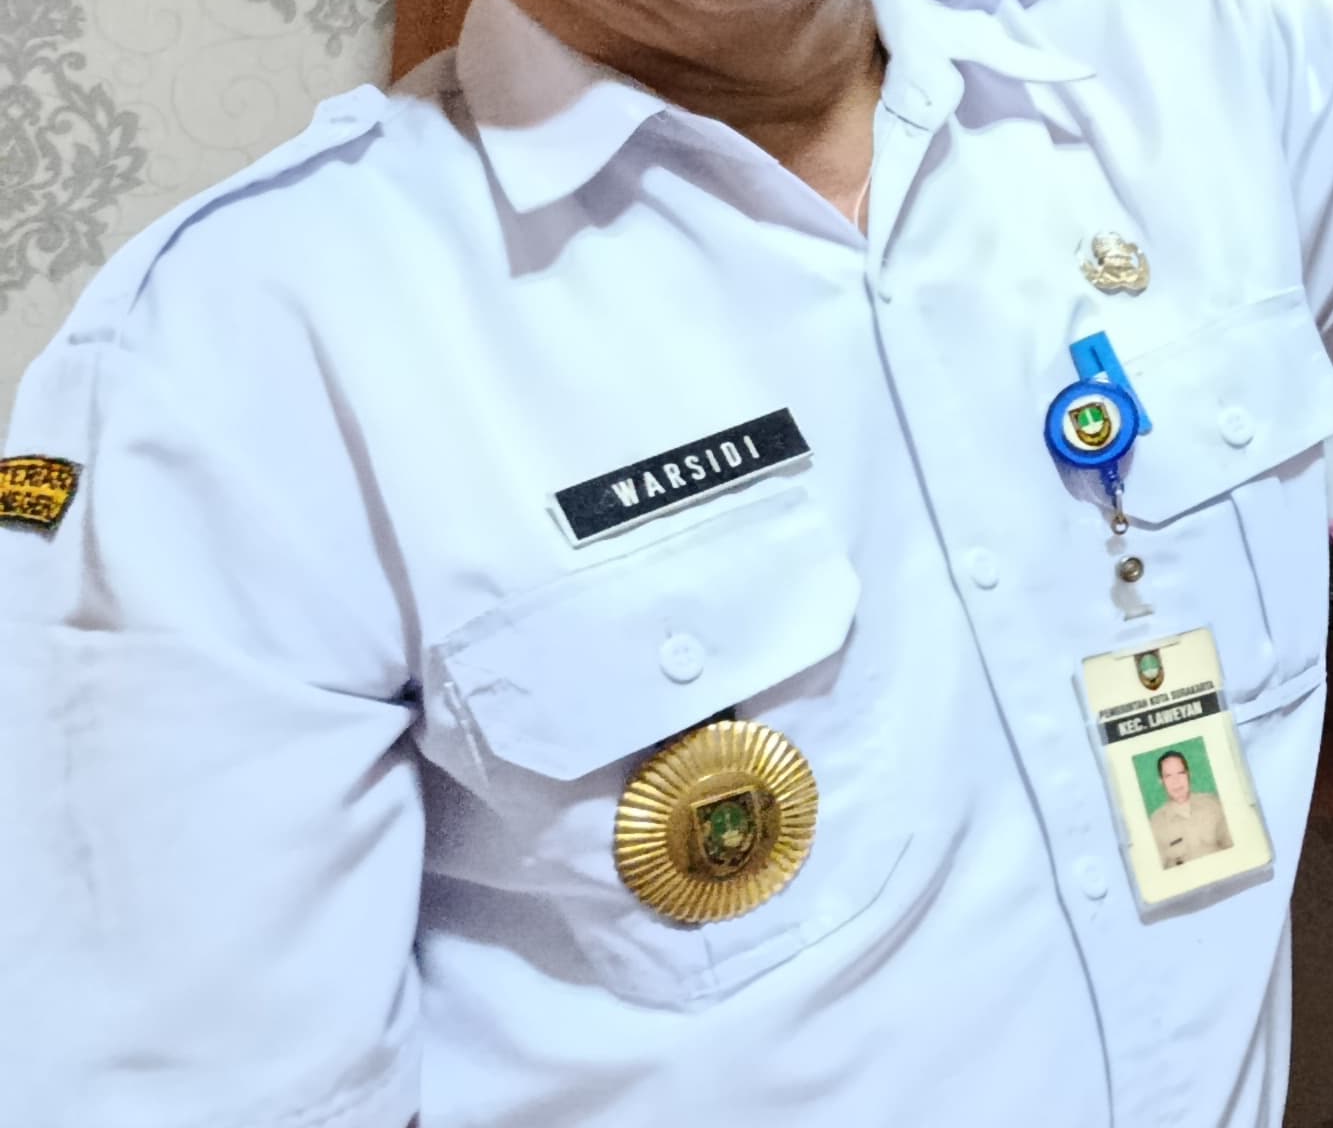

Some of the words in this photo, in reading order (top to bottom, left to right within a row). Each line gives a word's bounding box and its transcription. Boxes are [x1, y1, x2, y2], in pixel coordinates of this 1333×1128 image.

[611, 434, 760, 507] WARSIDI
[1118, 717, 1148, 737] KEC.
[1147, 700, 1203, 728] LAWEYAN
